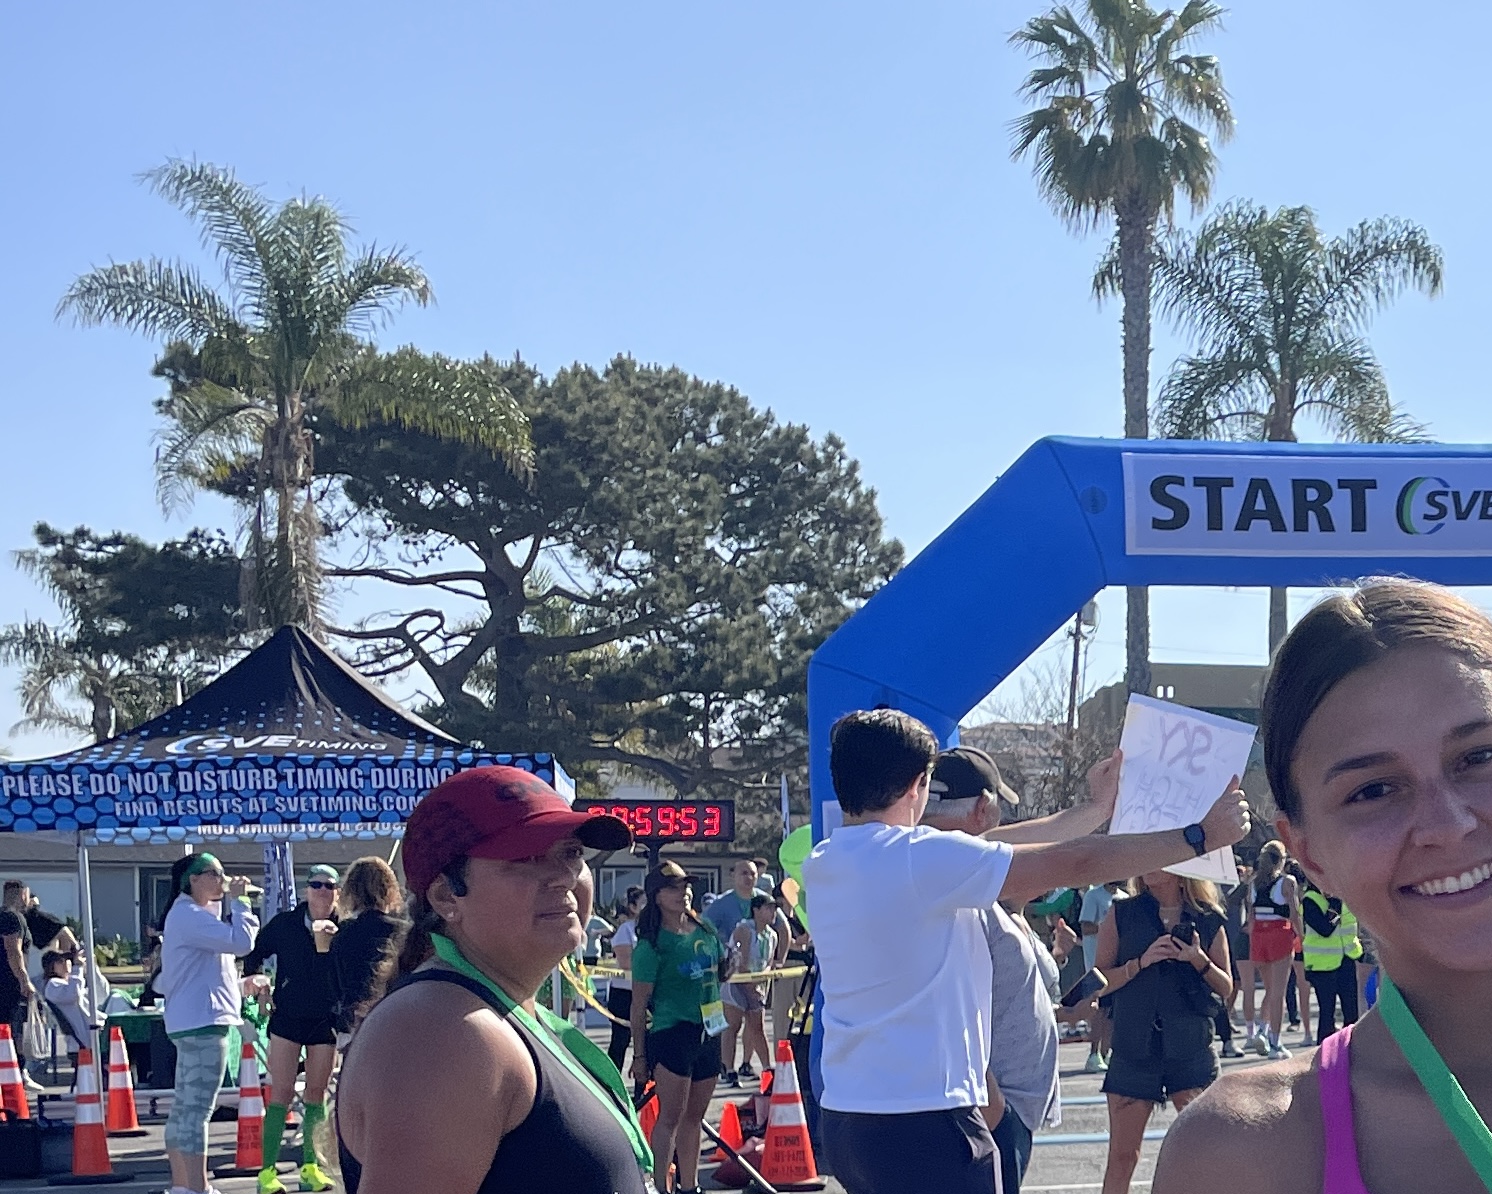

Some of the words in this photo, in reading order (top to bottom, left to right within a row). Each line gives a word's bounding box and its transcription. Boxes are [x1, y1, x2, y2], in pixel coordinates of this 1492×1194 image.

[1149, 475, 1378, 534] START
[2, 773, 83, 797] PLEASE
[90, 772, 121, 796] DO
[128, 771, 172, 795] NOT
[178, 768, 278, 793] DISTURB
[284, 767, 364, 791] TIMING
[115, 801, 157, 817] FIND
[164, 797, 243, 816] RESULTS
[249, 797, 268, 814] AT
[275, 795, 424, 813] SVETIMING.COM
